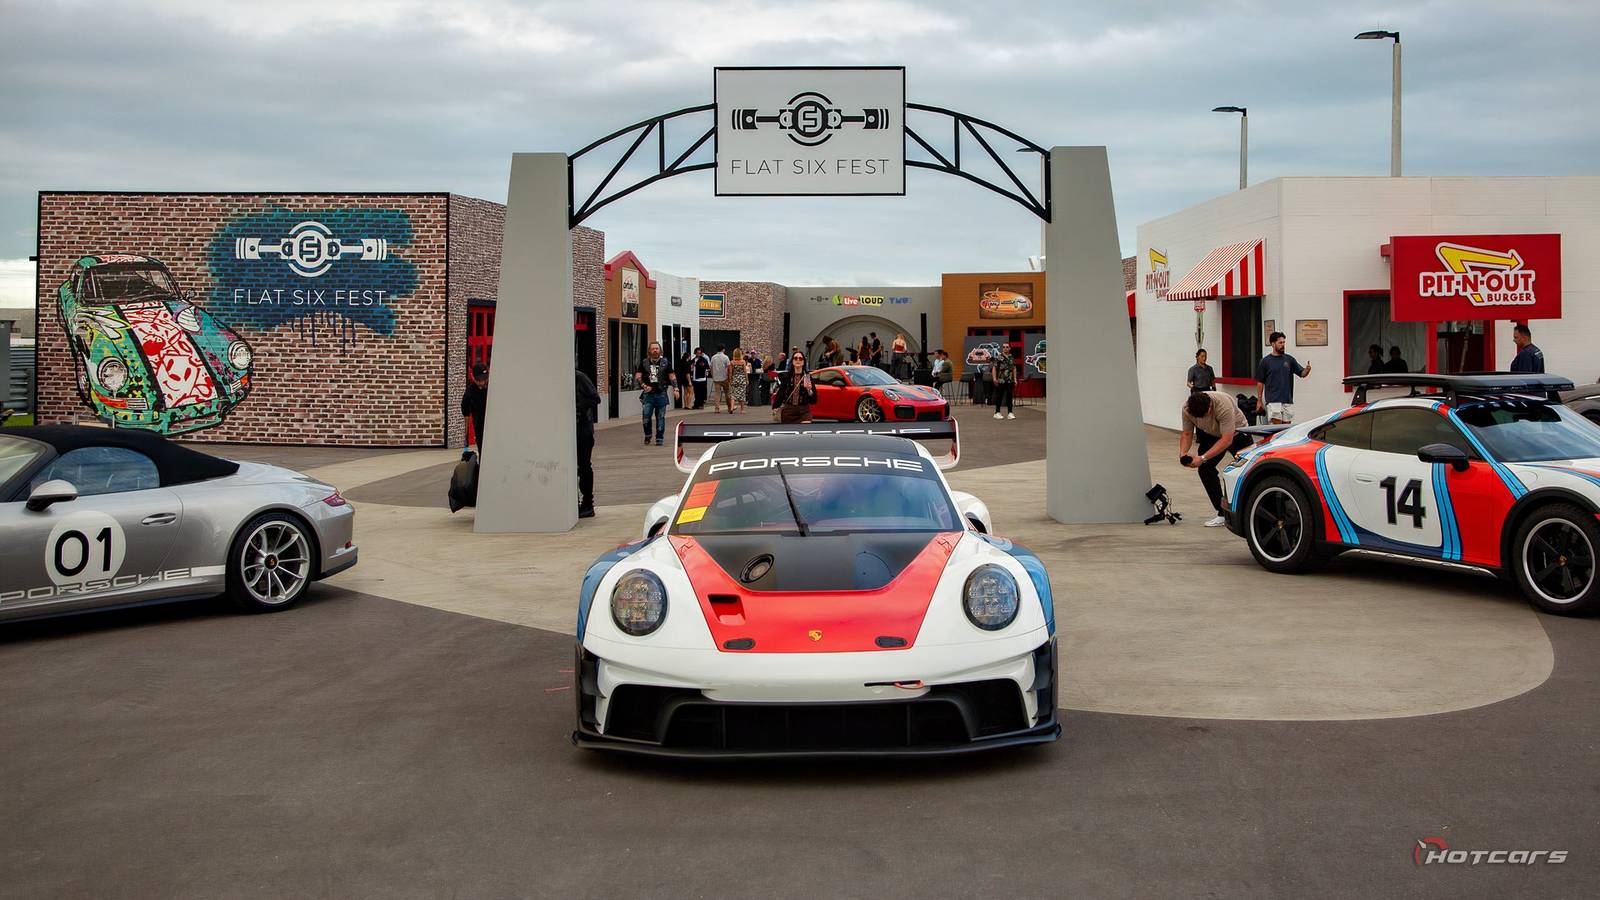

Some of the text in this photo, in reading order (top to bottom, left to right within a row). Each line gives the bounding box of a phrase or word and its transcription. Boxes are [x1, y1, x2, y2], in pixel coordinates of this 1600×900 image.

[731, 159, 890, 175] FLAT SIX FEST
[1422, 274, 1532, 292] PIT-N-OUT
[234, 288, 387, 306] FLAT SIX FEST
[861, 297, 884, 305] LOUD
[1487, 293, 1532, 302] BURGER
[708, 456, 924, 475] PORSCHE
[1380, 476, 1427, 529] 14
[54, 527, 113, 577] 01
[0, 567, 190, 600] PORSCHE
